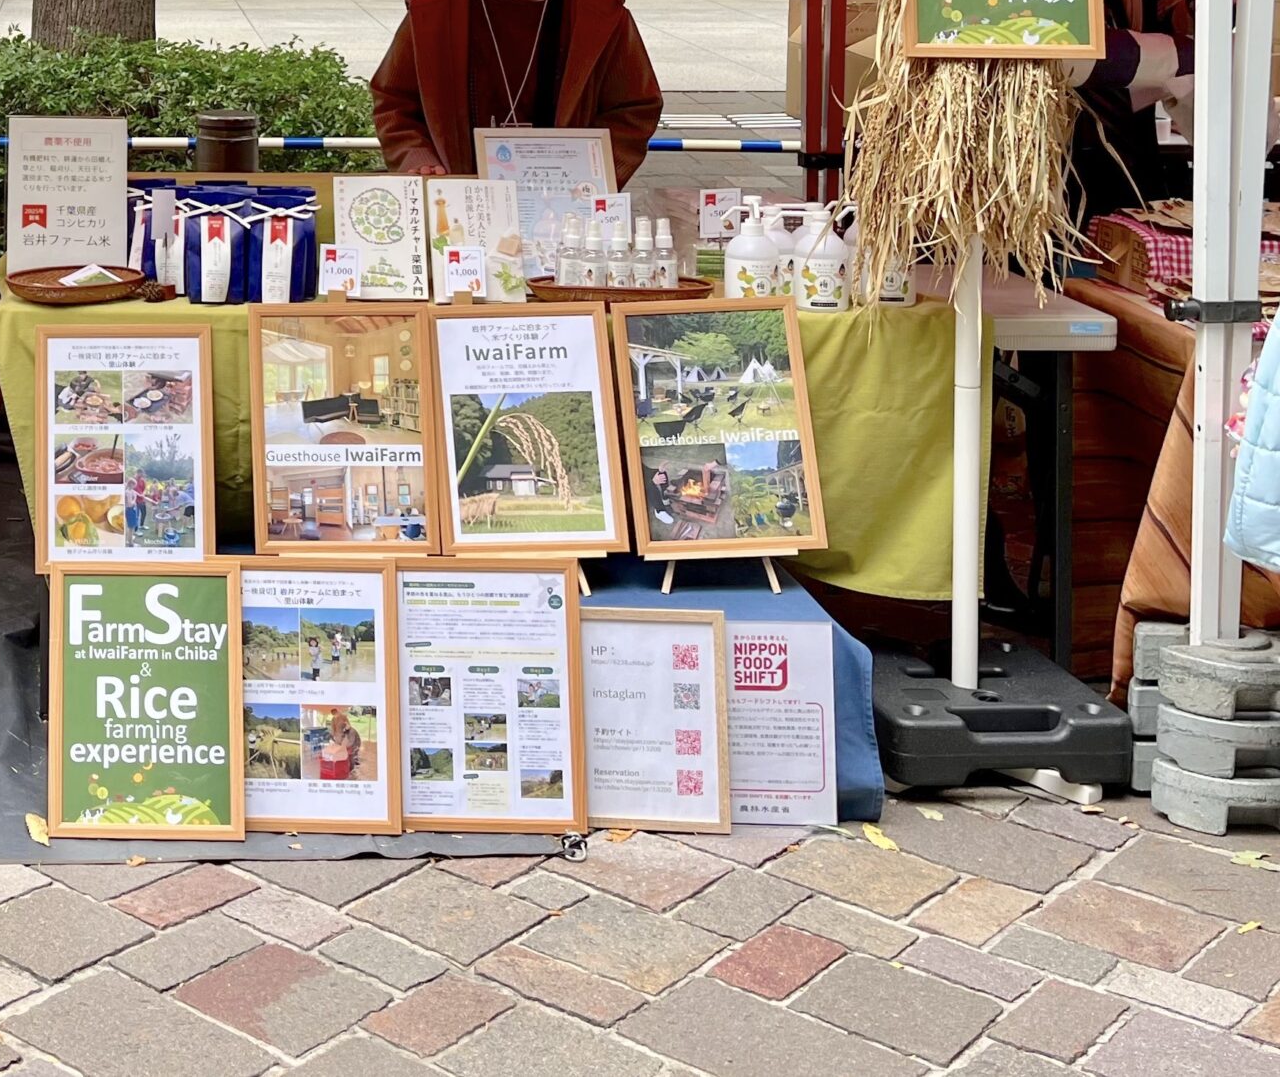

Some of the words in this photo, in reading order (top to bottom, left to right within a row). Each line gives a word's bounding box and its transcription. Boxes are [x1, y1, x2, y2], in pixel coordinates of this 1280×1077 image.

[56, 205, 97, 216] 千葉県産
[56, 218, 106, 228] コシヒカリ
[474, 185, 487, 252] からだ美人にな
[23, 234, 112, 247] 岩井ファーム米
[465, 343, 568, 361] IwaiFarm
[640, 433, 717, 447] Guesthouse
[720, 427, 799, 443] IwaiFarm
[266, 449, 341, 463] Guesthouse
[345, 448, 422, 463] IwaiFarm
[74, 649, 87, 659] at
[88, 646, 159, 660] IwaiFarm
[161, 649, 172, 660] in
[175, 646, 218, 660] Chiba
[734, 642, 788, 656] NIPPON
[139, 662, 152, 677] &
[734, 656, 773, 670] FOOD
[734, 670, 778, 684] SHIFT
[96, 674, 198, 720] Rice
[592, 688, 646, 701] instaglam
[104, 718, 188, 745] farming
[70, 738, 226, 769] experience
